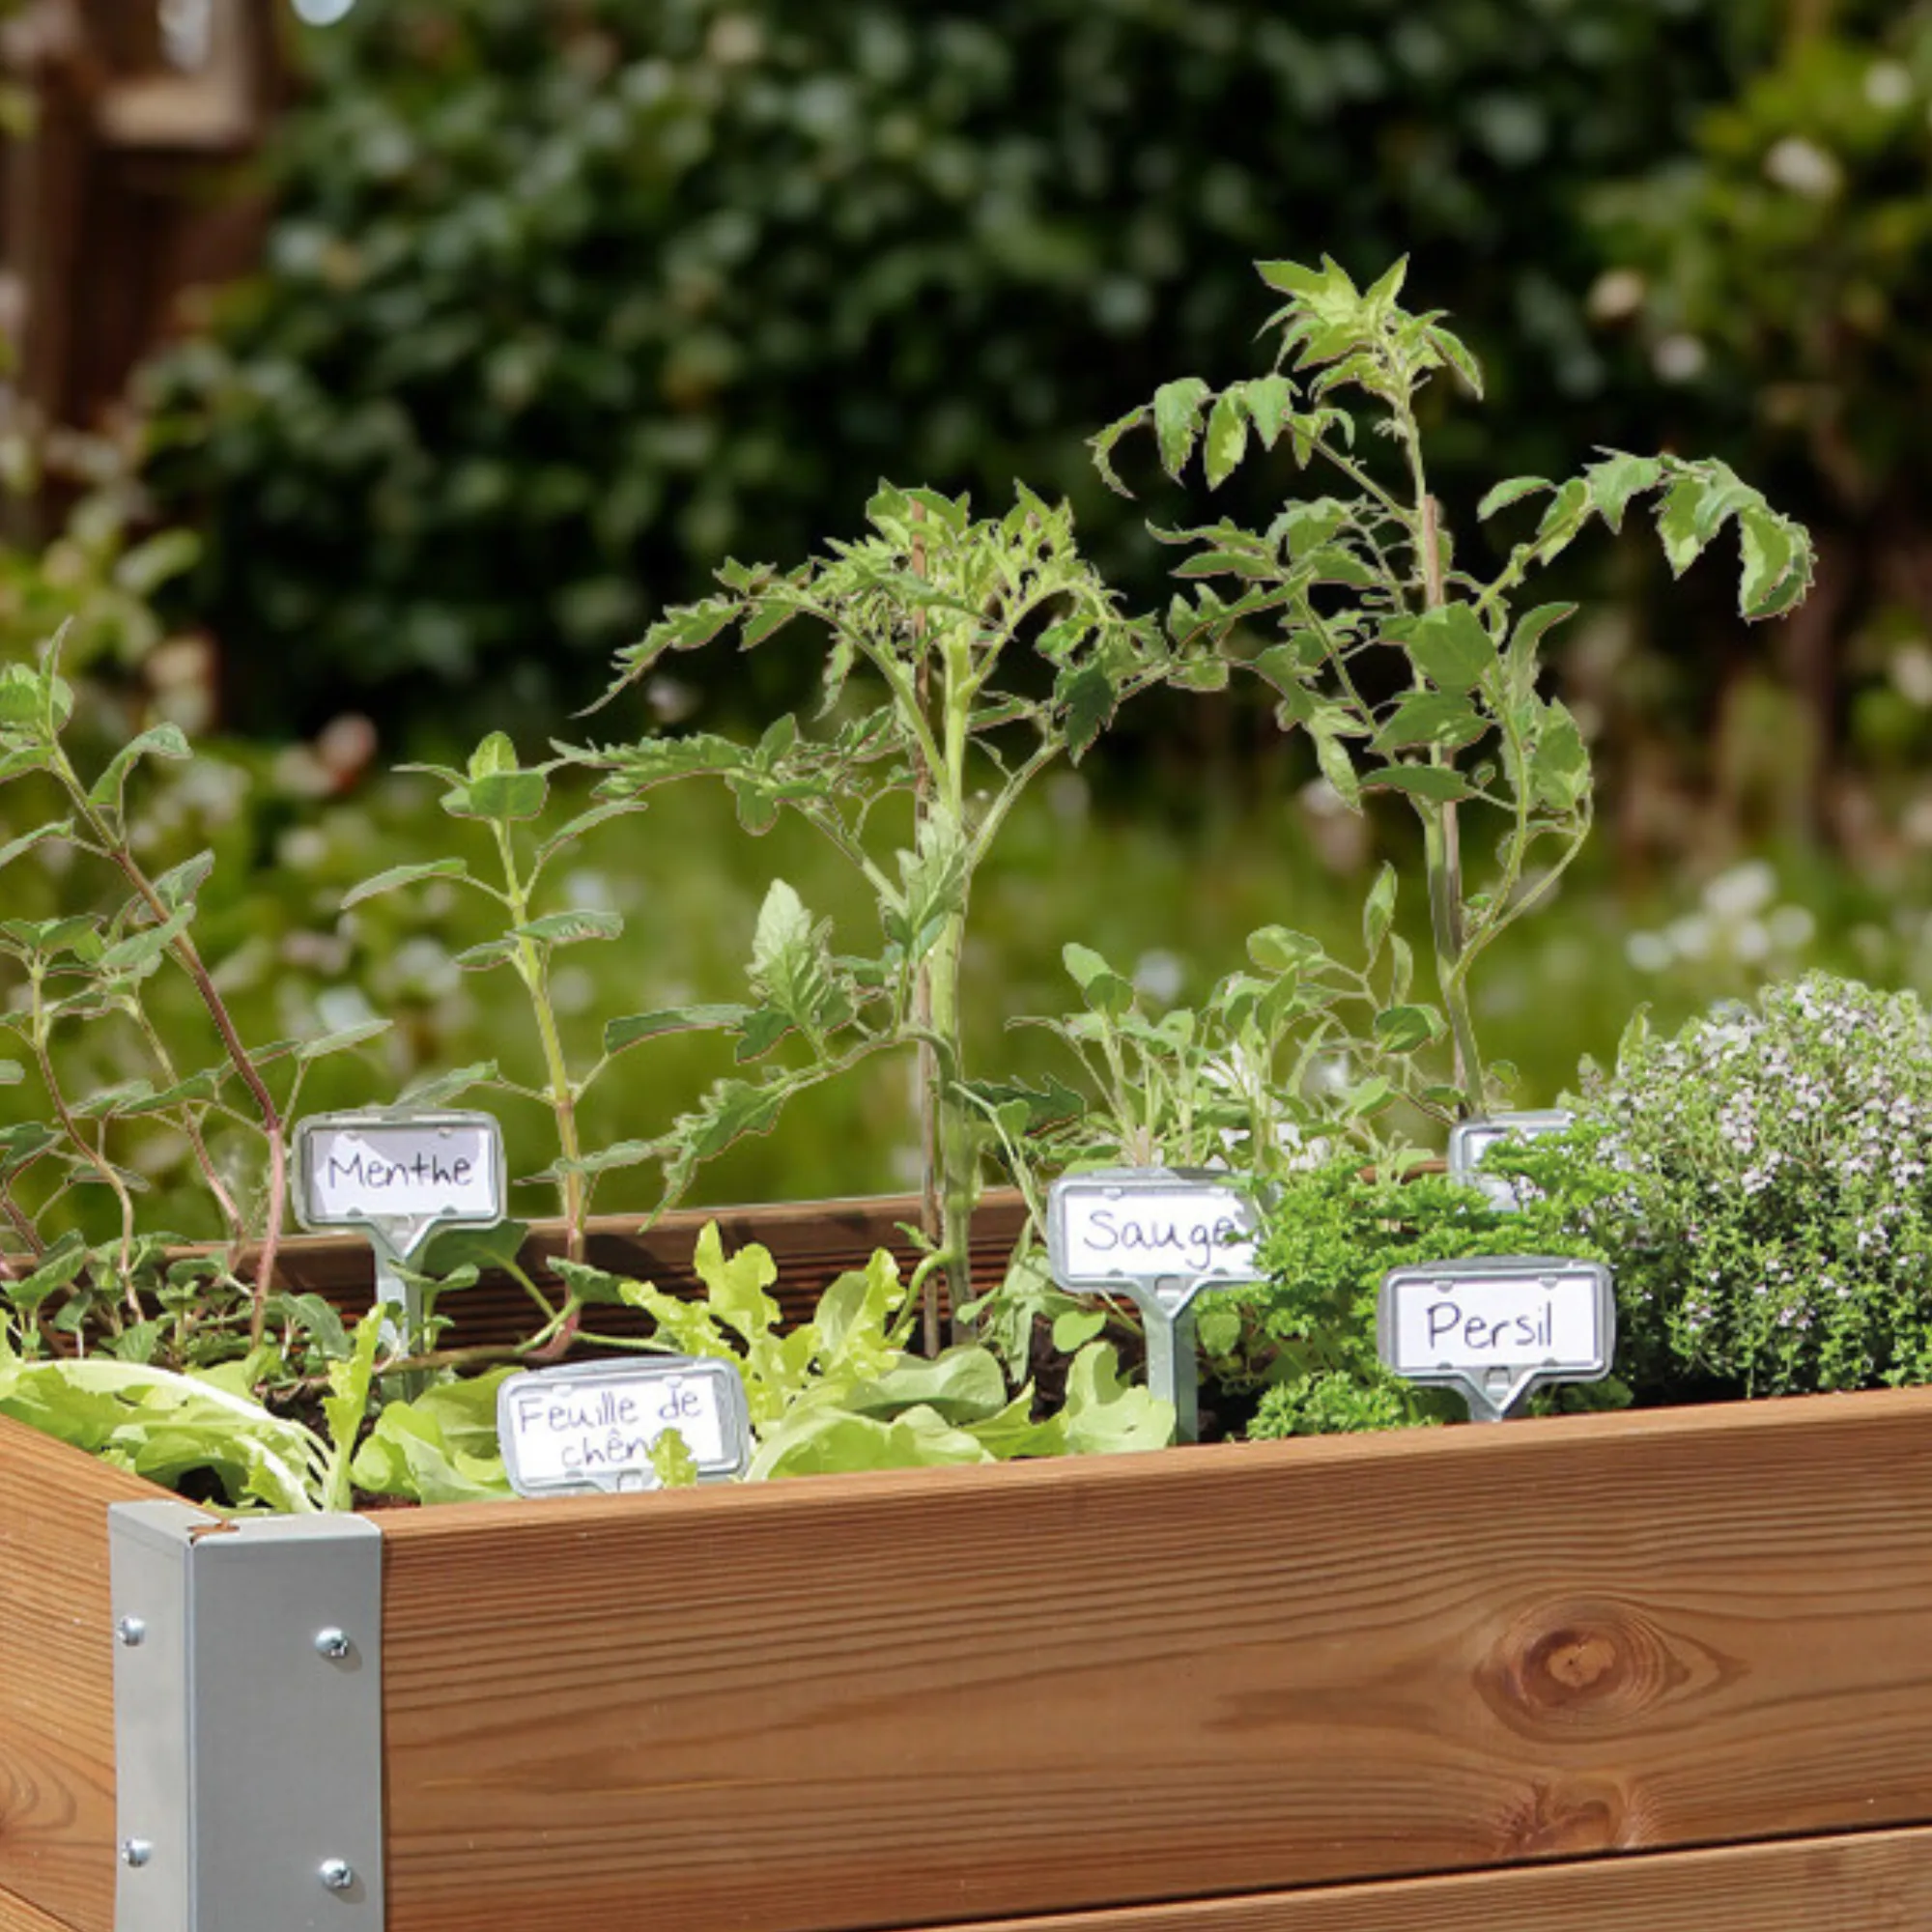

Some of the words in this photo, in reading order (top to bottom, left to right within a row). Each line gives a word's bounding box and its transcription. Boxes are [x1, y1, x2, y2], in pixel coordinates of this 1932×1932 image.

[327, 1151, 472, 1189] Menthe
[1083, 1209, 1236, 1271] Sauge
[1426, 1300, 1551, 1350] Persil
[518, 1392, 639, 1434] Feuille
[658, 1388, 702, 1421] de
[561, 1427, 665, 1467] chên
